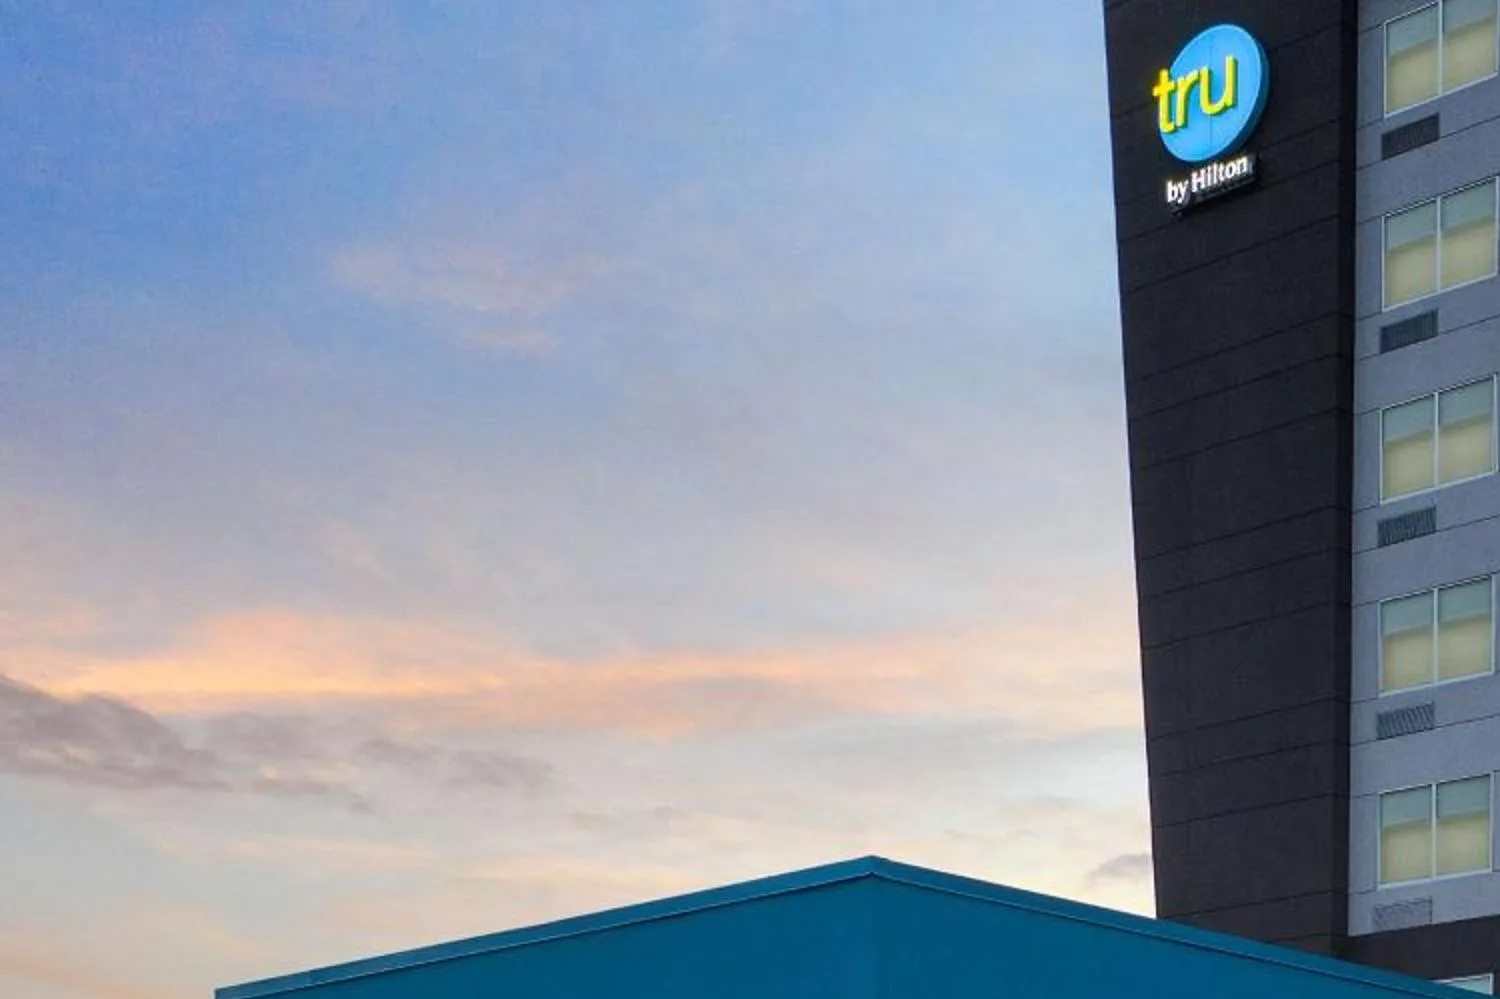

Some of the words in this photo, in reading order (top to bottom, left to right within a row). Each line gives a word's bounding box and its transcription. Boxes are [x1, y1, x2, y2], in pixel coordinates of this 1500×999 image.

[1152, 55, 1237, 133] tru
[1166, 178, 1190, 204] by
[1191, 156, 1249, 193] Hilton
